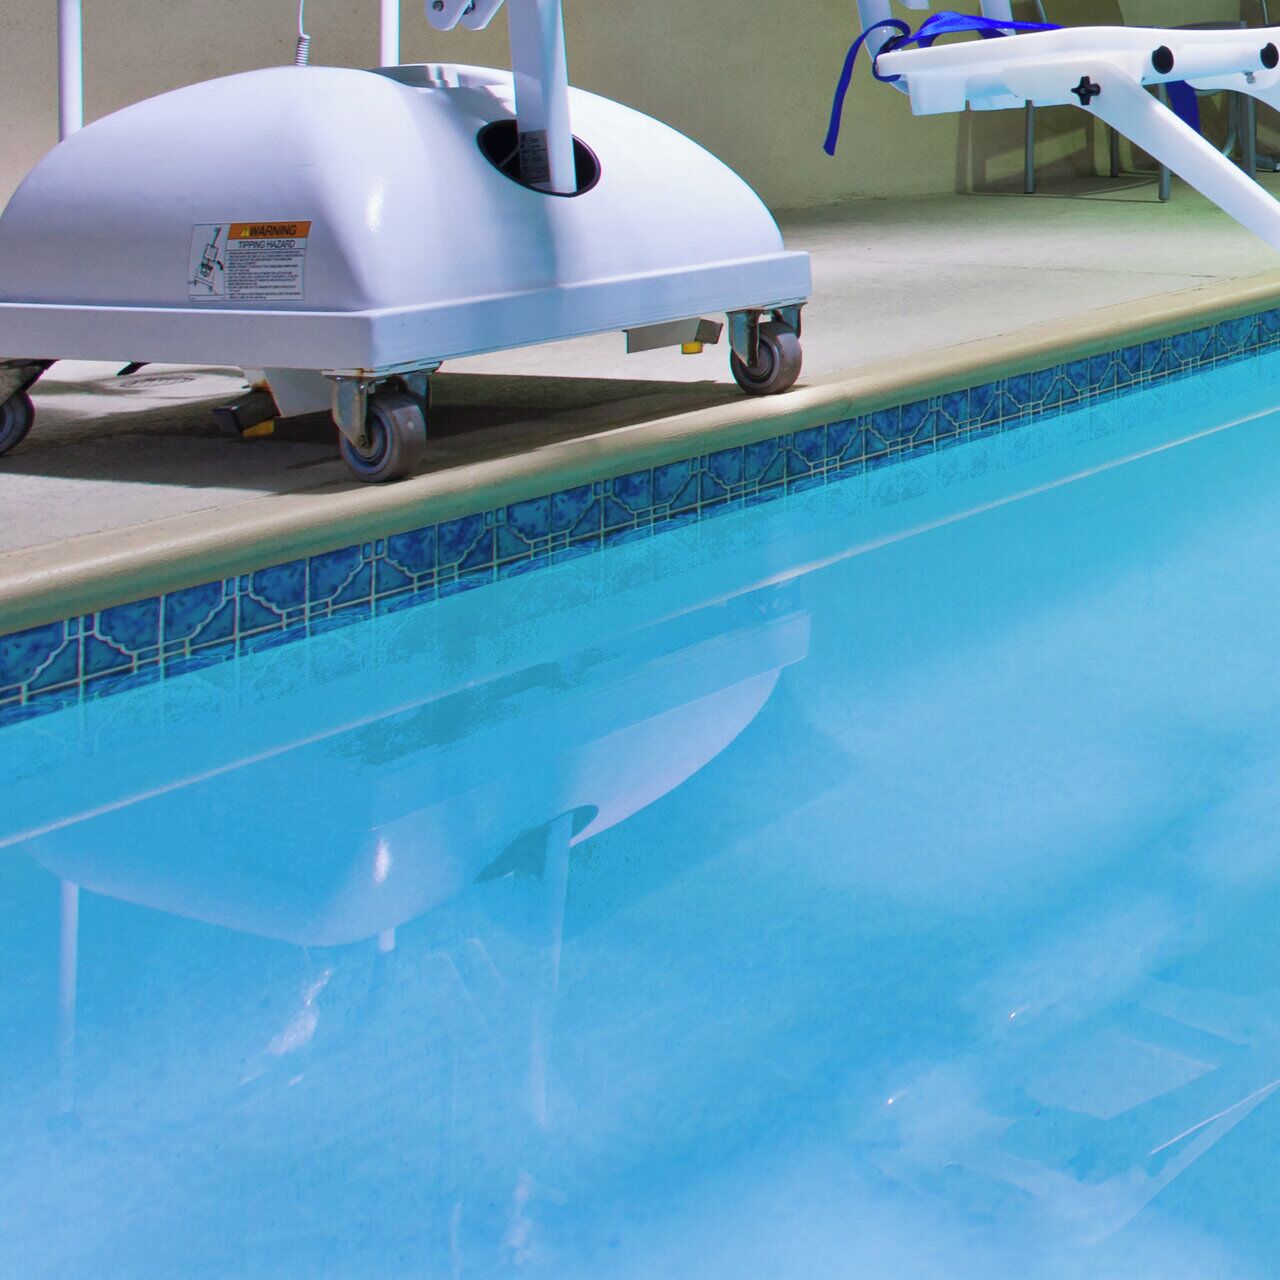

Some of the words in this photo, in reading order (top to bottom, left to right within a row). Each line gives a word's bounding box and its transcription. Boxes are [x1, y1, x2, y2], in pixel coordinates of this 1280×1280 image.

[249, 224, 298, 237] WARNING
[238, 240, 265, 249] TIPPING
[266, 239, 296, 249] HAZARD
